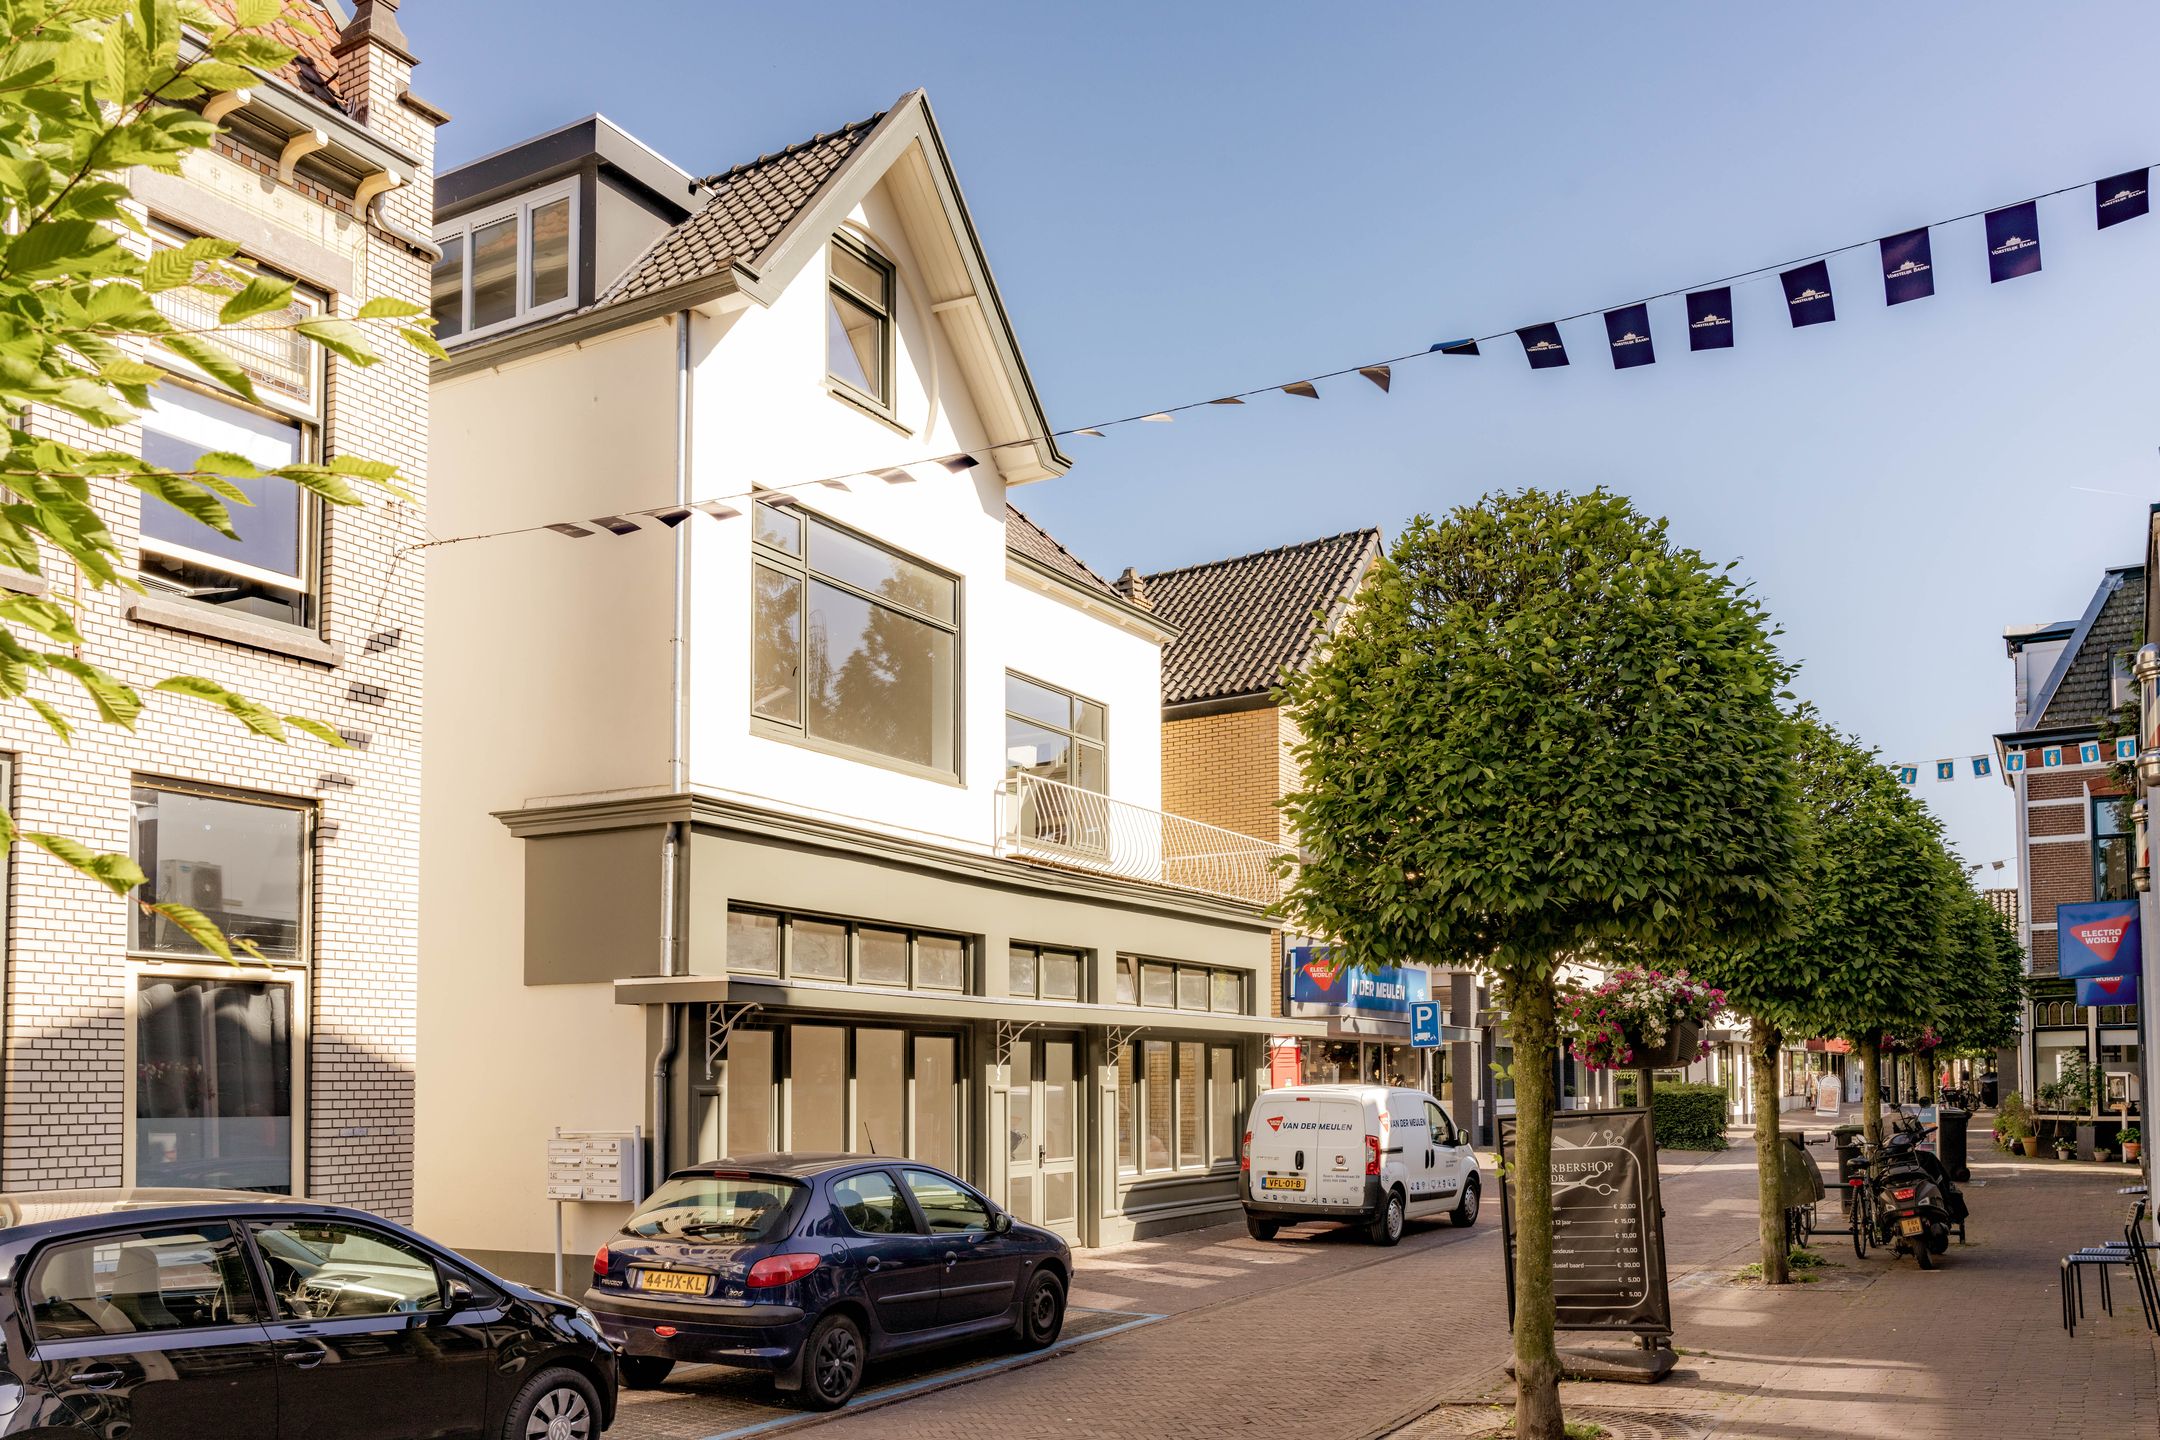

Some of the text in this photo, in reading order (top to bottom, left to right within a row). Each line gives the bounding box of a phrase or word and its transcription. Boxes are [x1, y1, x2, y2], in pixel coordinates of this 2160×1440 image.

[2081, 928, 2122, 937] ELECTRO
[2085, 936, 2119, 945] WORLD
[1359, 980, 1374, 997] DER
[1376, 982, 1405, 1000] MEULEN
[1416, 1006, 1432, 1030] P
[1614, 1070, 1637, 1084] Jacq
[1318, 1123, 1353, 1131] MEULEN
[1551, 1161, 1614, 1173] RBERSHOP
[1269, 1179, 1302, 1188] VFL-01-B
[646, 1273, 702, 1291] 44-HX-KL
